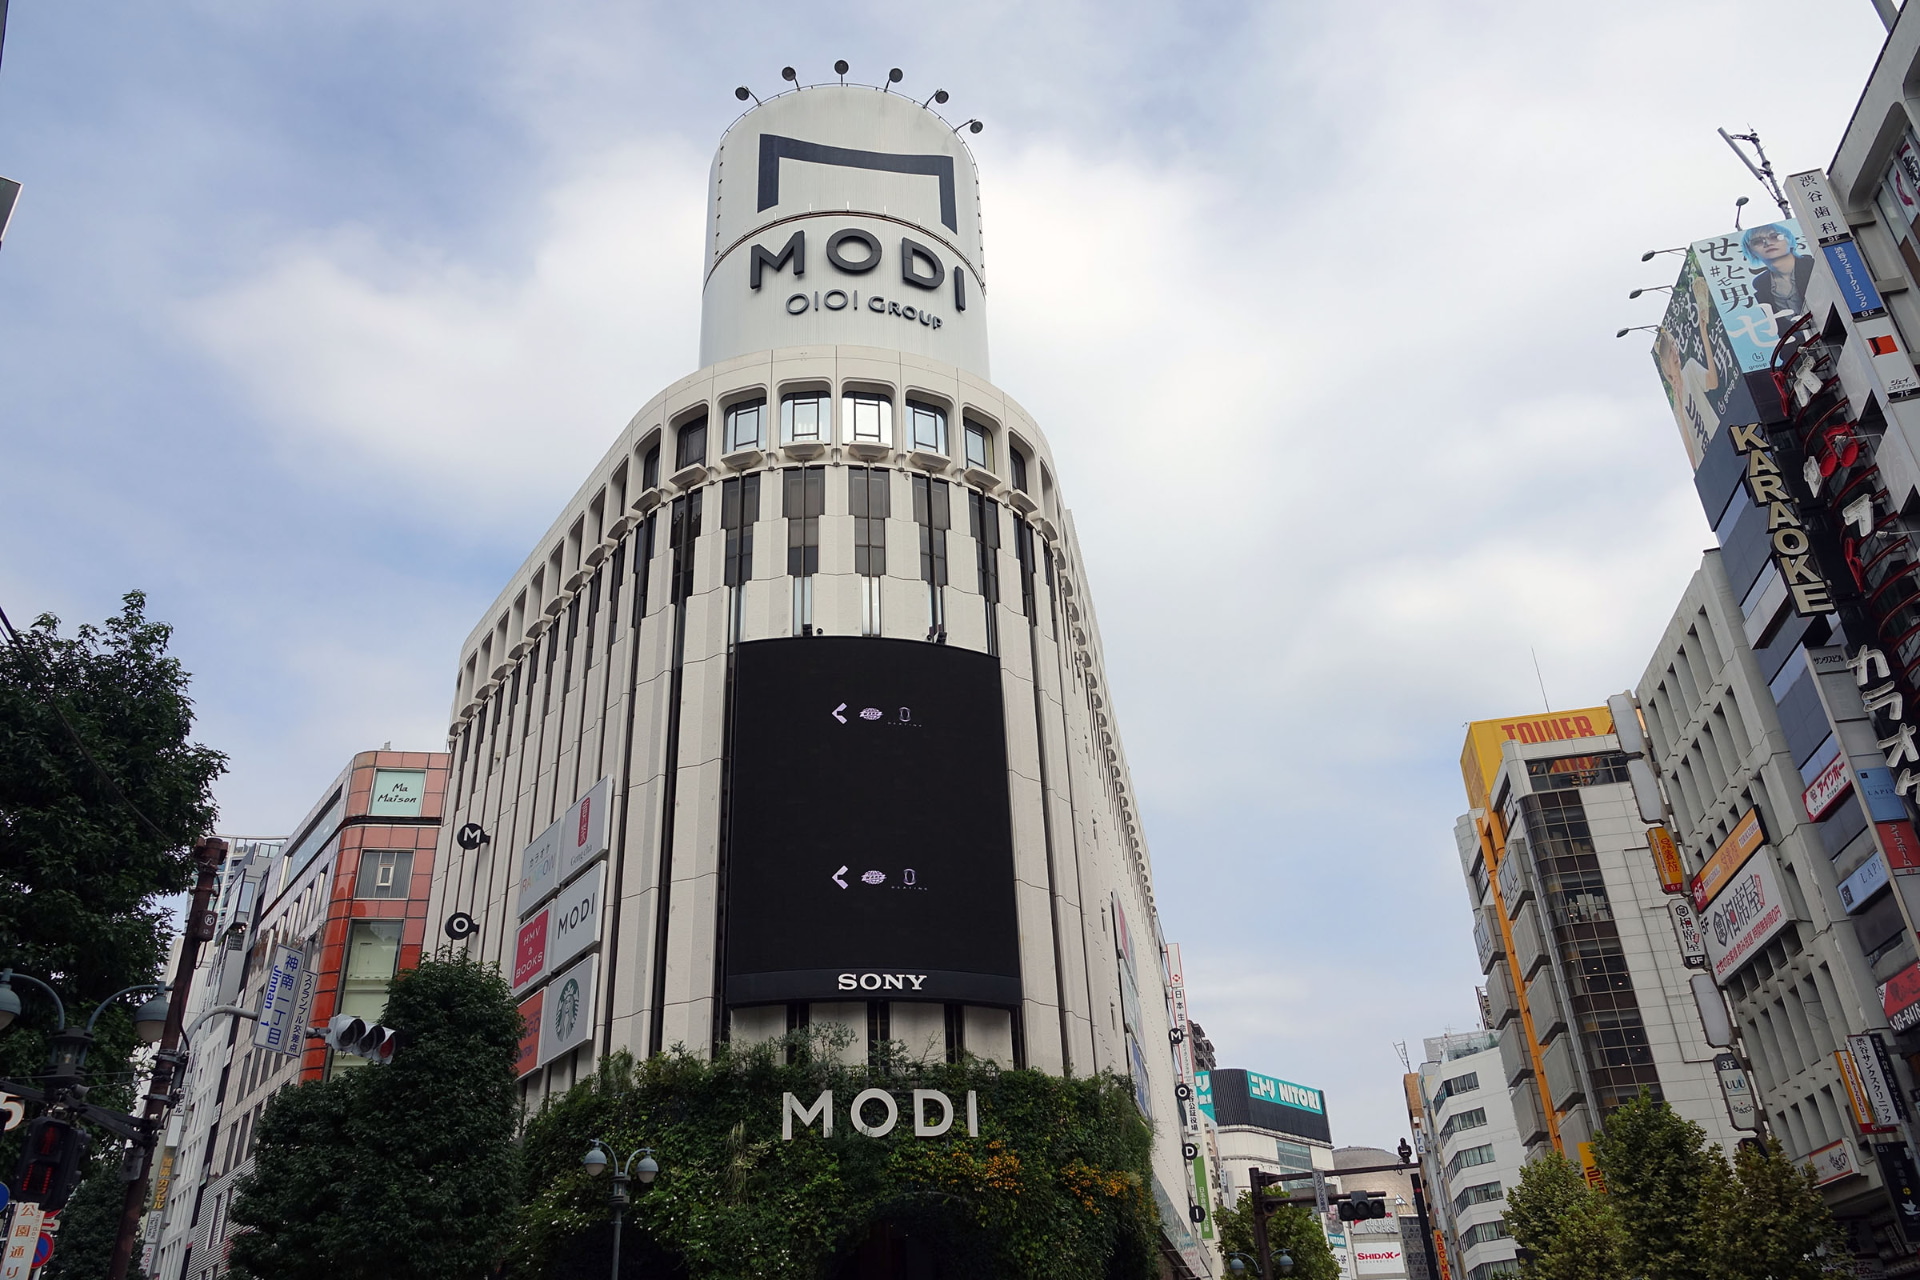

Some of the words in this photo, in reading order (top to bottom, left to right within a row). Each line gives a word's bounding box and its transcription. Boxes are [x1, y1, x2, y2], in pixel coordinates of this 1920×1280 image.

[1800, 175, 1837, 234] 渋谷歯科
[750, 228, 966, 312] MODI
[868, 295, 943, 329] GROUP
[1731, 423, 1834, 612] KARAOKE
[1501, 715, 1596, 744] TOWER
[377, 793, 417, 803] Maison
[392, 783, 408, 792] Ma
[557, 892, 595, 940] MODI
[523, 925, 541, 946] HMV
[515, 951, 543, 979] BOOKS
[1690, 956, 1703, 964] 5F
[265, 965, 282, 1009] Jinnan
[268, 954, 299, 1045] 神南一丁目
[837, 973, 927, 991] SONY
[289, 974, 313, 1053] スクランブル交差点
[1175, 990, 1187, 1032] 日本生命
[1721, 1061, 1735, 1070] 3F
[1250, 1074, 1275, 1100] ニトリ
[1279, 1082, 1320, 1110] NITORI
[781, 1088, 979, 1141] MODI
[1416, 1130, 1424, 1153] ITC
[6, 1205, 36, 1278] 公園通り
[1357, 1252, 1395, 1260] SHIDAX
